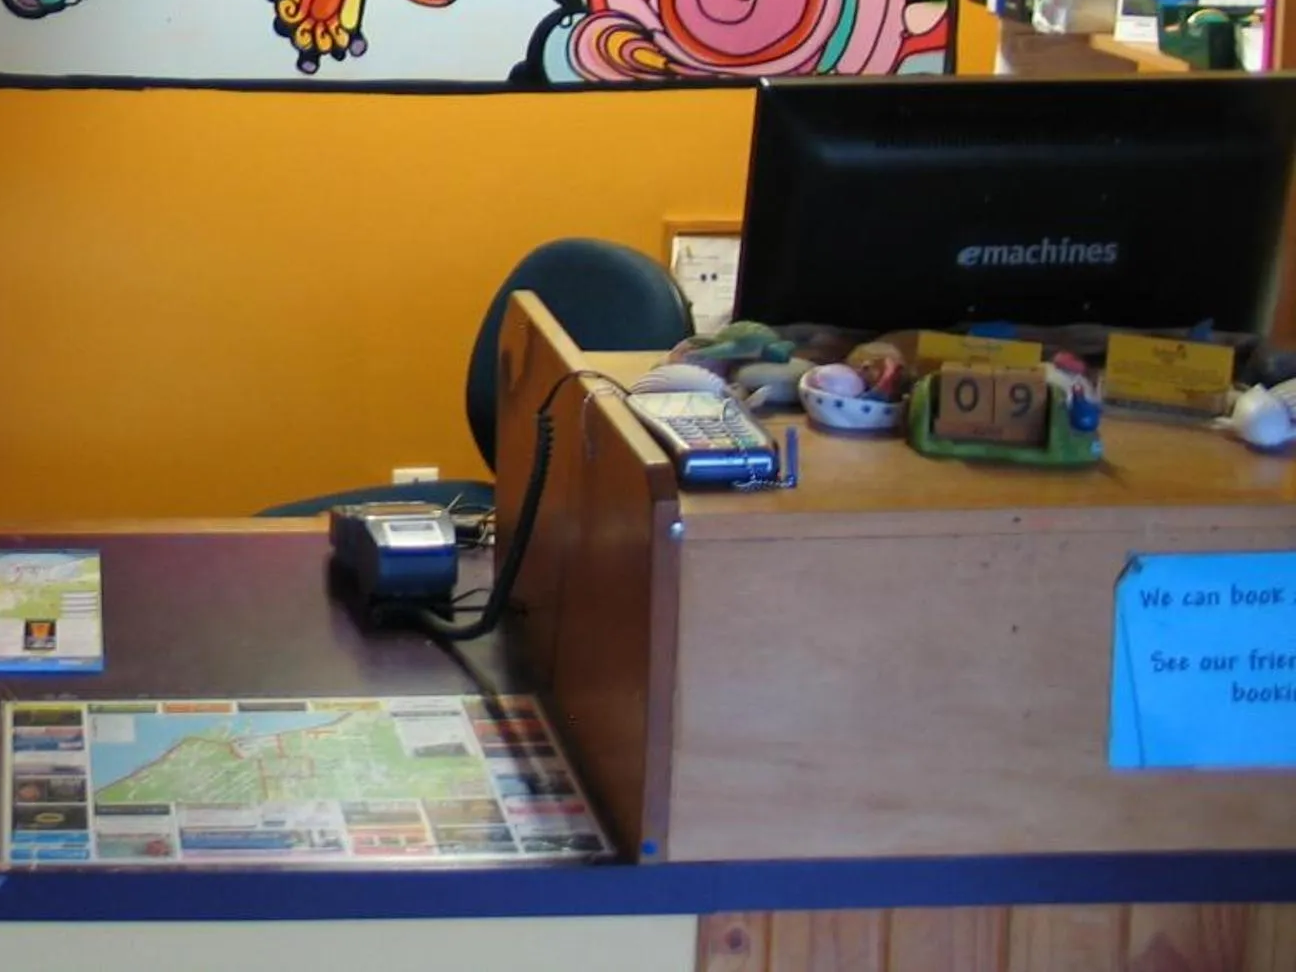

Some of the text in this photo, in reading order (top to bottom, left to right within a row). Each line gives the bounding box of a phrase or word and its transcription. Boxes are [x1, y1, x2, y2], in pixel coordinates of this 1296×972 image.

[957, 238, 1118, 266] emachines
[1140, 583, 1286, 608] We can book
[1150, 650, 1191, 673] See
[1199, 655, 1239, 671] our
